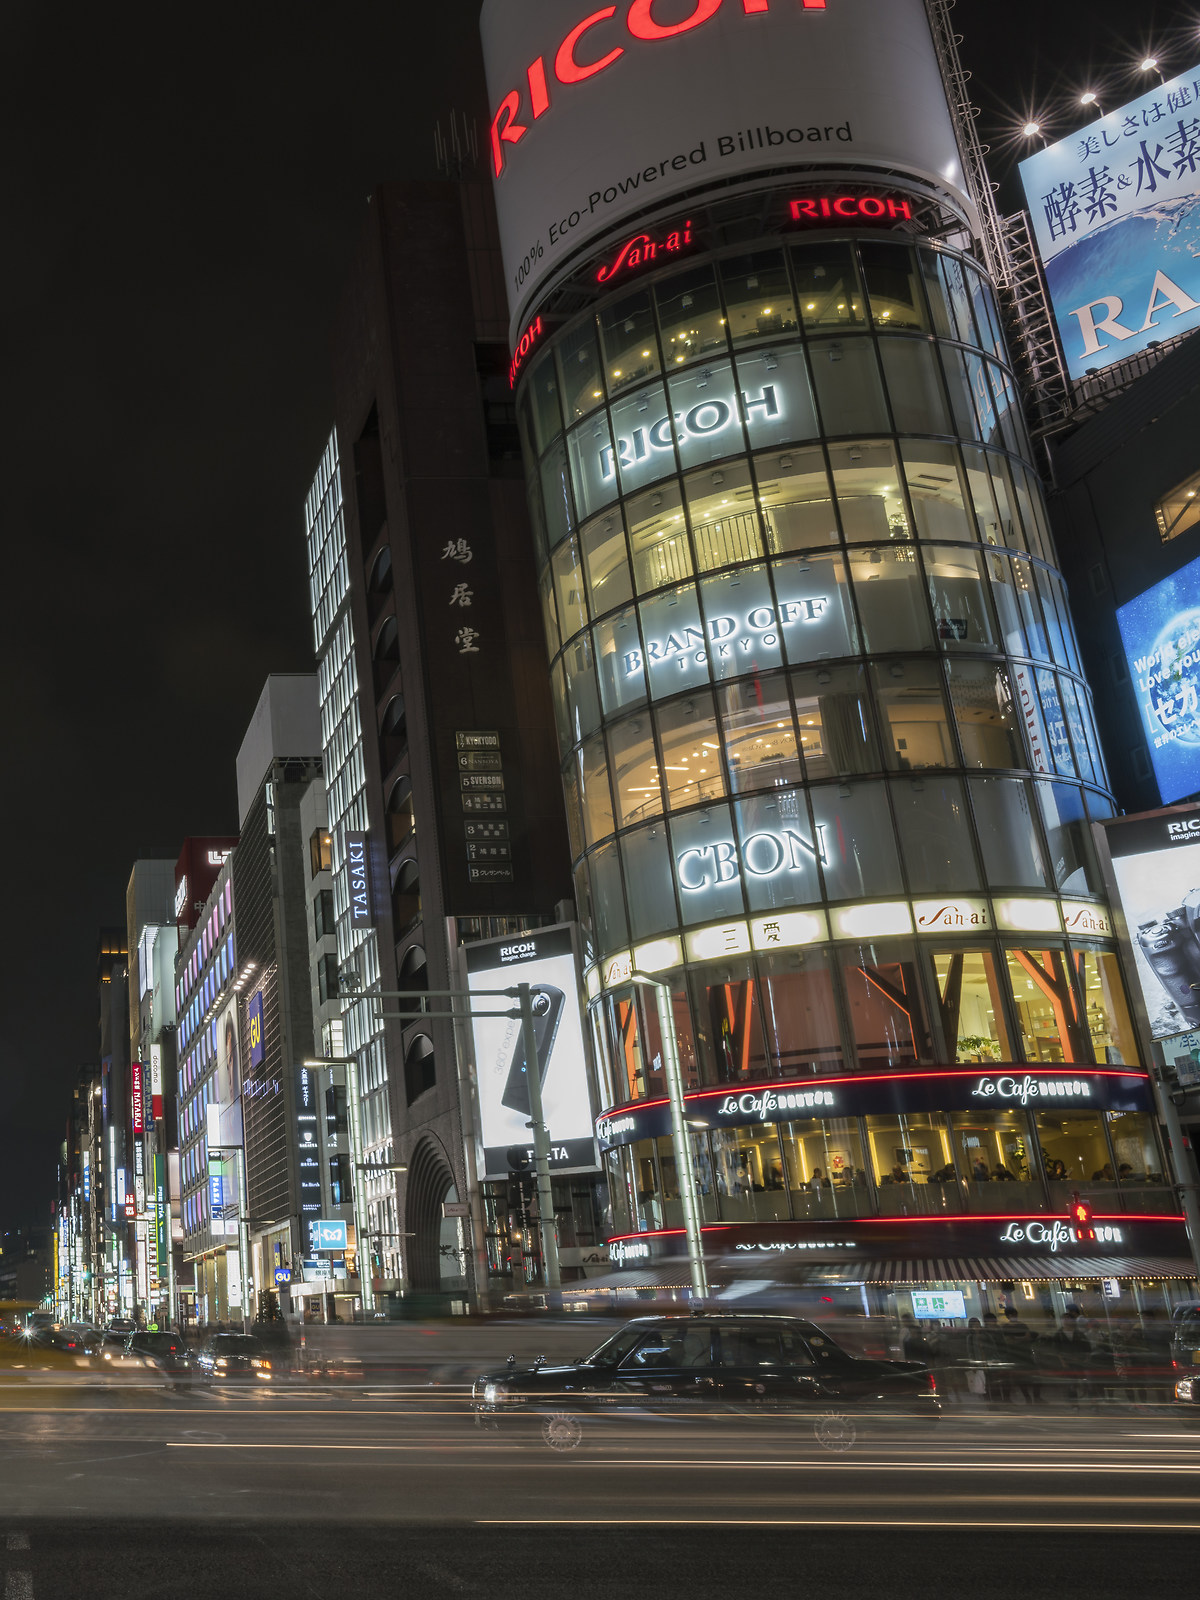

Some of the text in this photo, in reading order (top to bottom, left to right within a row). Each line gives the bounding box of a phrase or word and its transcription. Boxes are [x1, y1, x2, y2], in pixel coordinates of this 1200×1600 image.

[1077, 80, 1200, 163] 美しさは健
[514, 121, 853, 292] 100% Eco-Powered Billboard
[790, 197, 912, 220] RICOH
[597, 220, 693, 282] San-ai
[600, 385, 779, 479] RICOH
[441, 538, 480, 653] 鳩居堂
[623, 598, 828, 675] BRAND OFF
[678, 633, 776, 669] TOKYO
[1139, 668, 1171, 692] Love
[460, 757, 467, 765] 6
[463, 778, 470, 786] 5
[470, 776, 501, 785] SVENSON
[465, 799, 472, 807] 4
[467, 826, 475, 834] 3
[677, 824, 828, 890] C'BON
[349, 842, 368, 919] TASAKI
[471, 869, 479, 877] B
[919, 905, 987, 926] San-ai
[1065, 909, 1109, 931] San-ai
[501, 942, 535, 957] RICOH
[723, 922, 781, 950] 三愛
[250, 1012, 261, 1048] GU
[718, 1096, 738, 1114] Le
[739, 1090, 777, 1119] Café
[972, 1077, 996, 1096] Le
[997, 1075, 1039, 1105] Café
[134, 1092, 142, 1128] NATARAJ
[1000, 1222, 1024, 1241] Le
[1026, 1221, 1069, 1251] Café
[275, 1273, 290, 1281] GU
